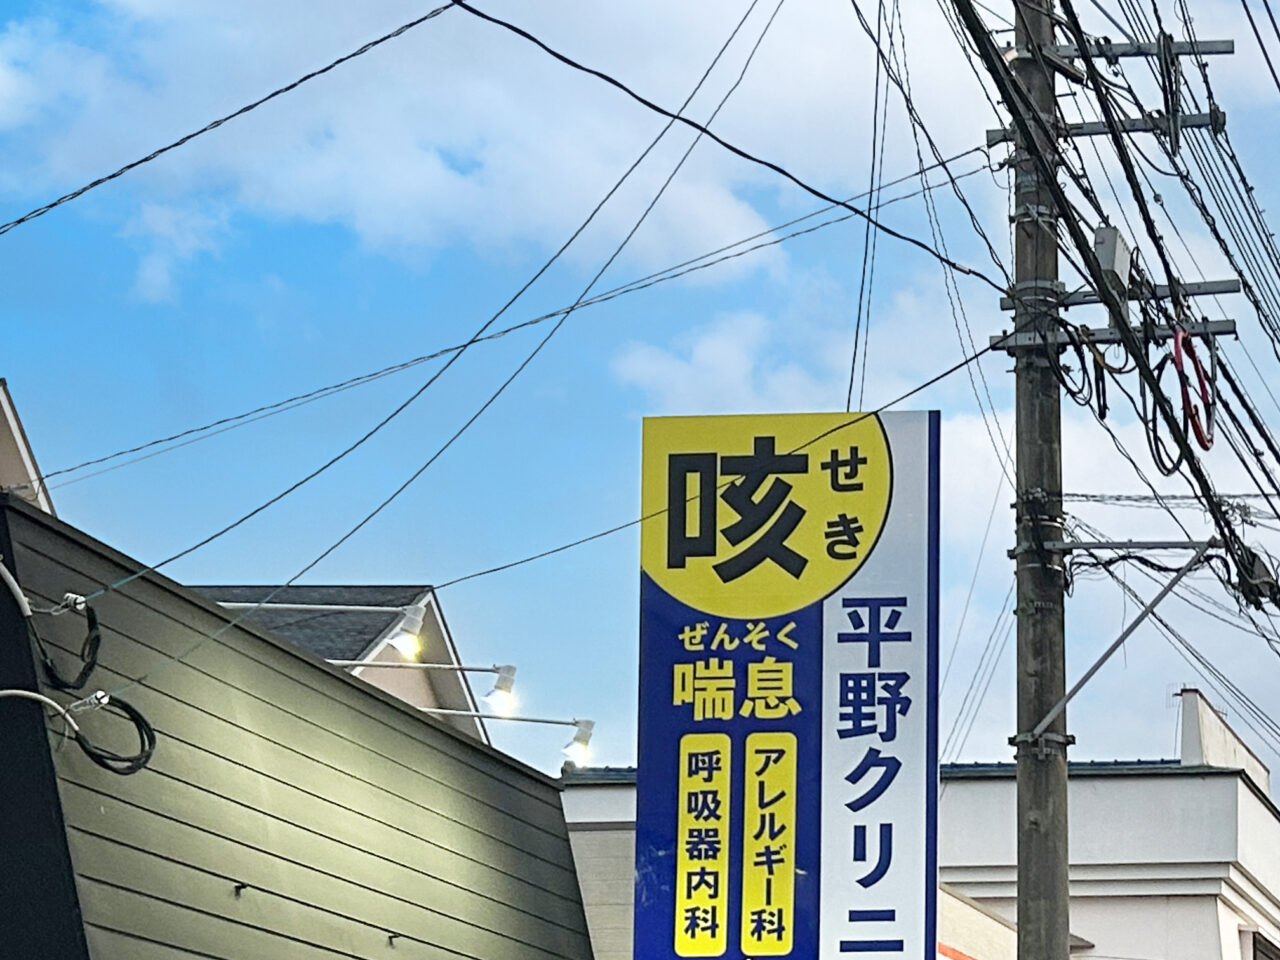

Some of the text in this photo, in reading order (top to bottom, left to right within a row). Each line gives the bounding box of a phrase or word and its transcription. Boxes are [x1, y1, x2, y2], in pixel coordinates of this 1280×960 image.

[667, 436, 809, 583] 咳
[820, 447, 867, 560] せき
[673, 656, 802, 722] 喘息
[678, 622, 799, 650] ぜんそく
[684, 750, 722, 939] 呼吸器内科
[750, 749, 787, 941] アレルギー科
